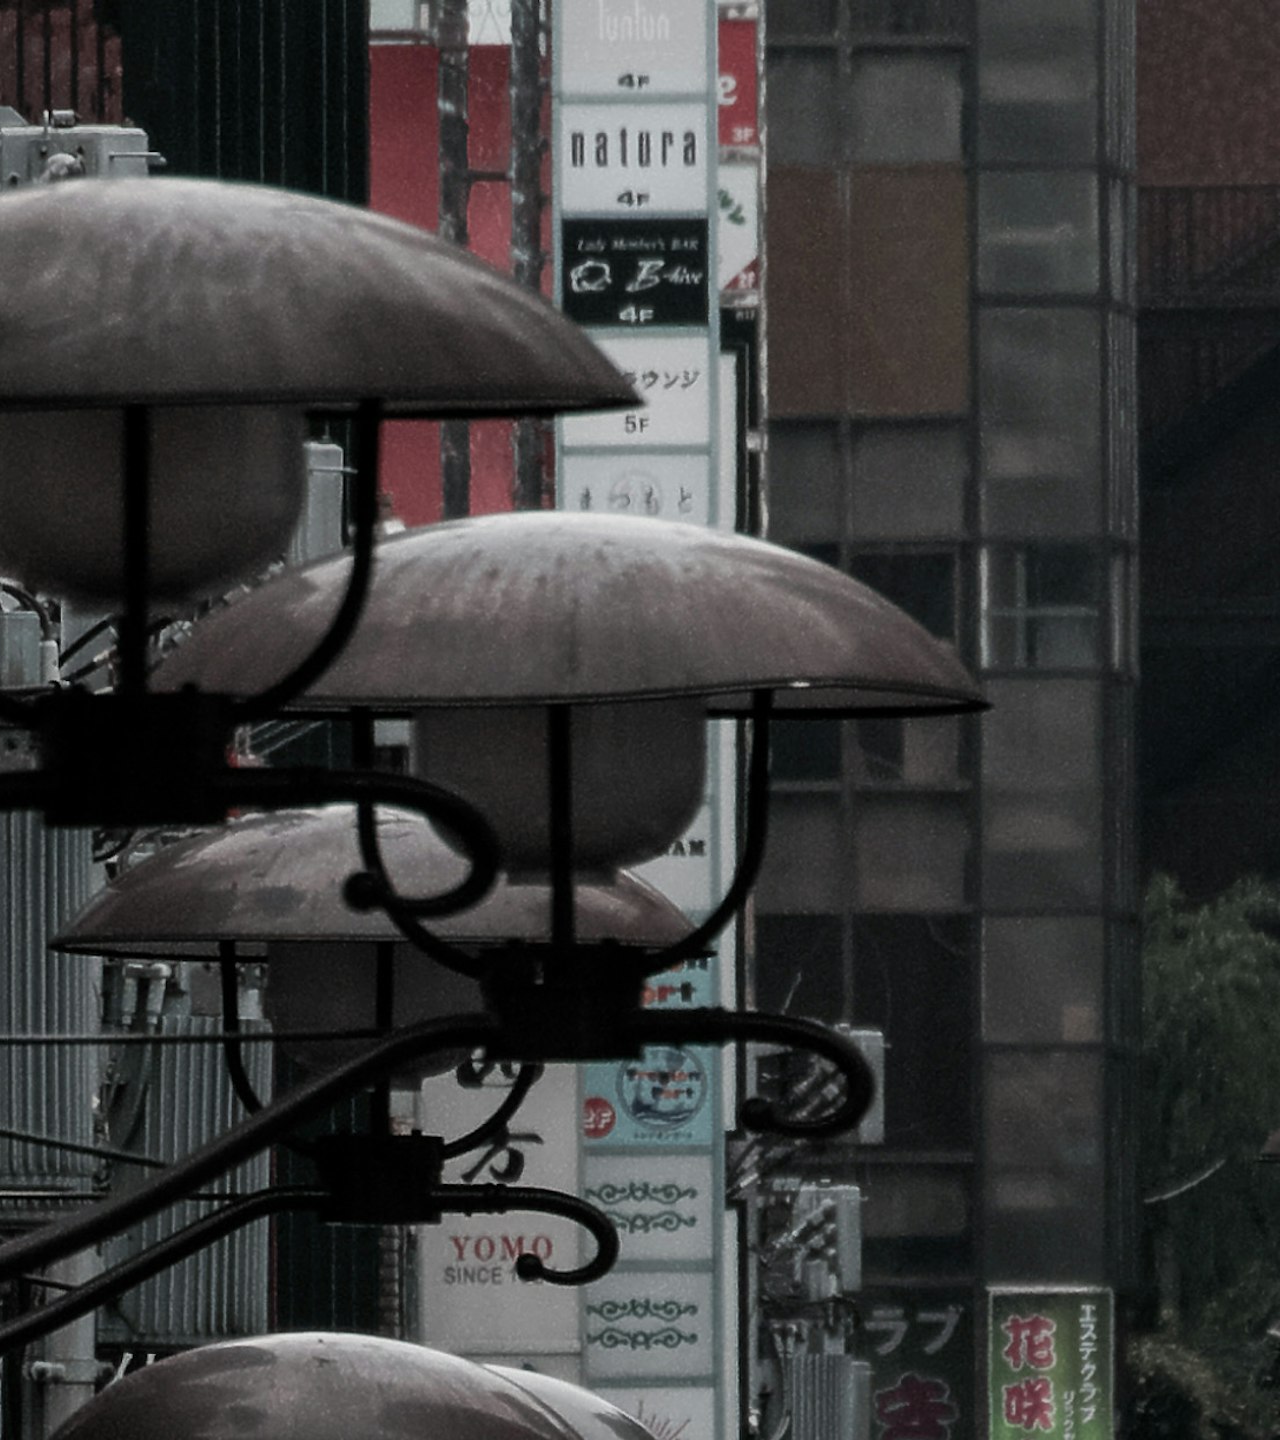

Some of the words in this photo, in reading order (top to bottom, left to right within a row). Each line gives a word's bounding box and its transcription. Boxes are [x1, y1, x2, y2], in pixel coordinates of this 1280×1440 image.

[571, 126, 696, 168] natura
[617, 190, 650, 207] 4F
[618, 305, 656, 323] 4F
[625, 414, 651, 434] 5F
